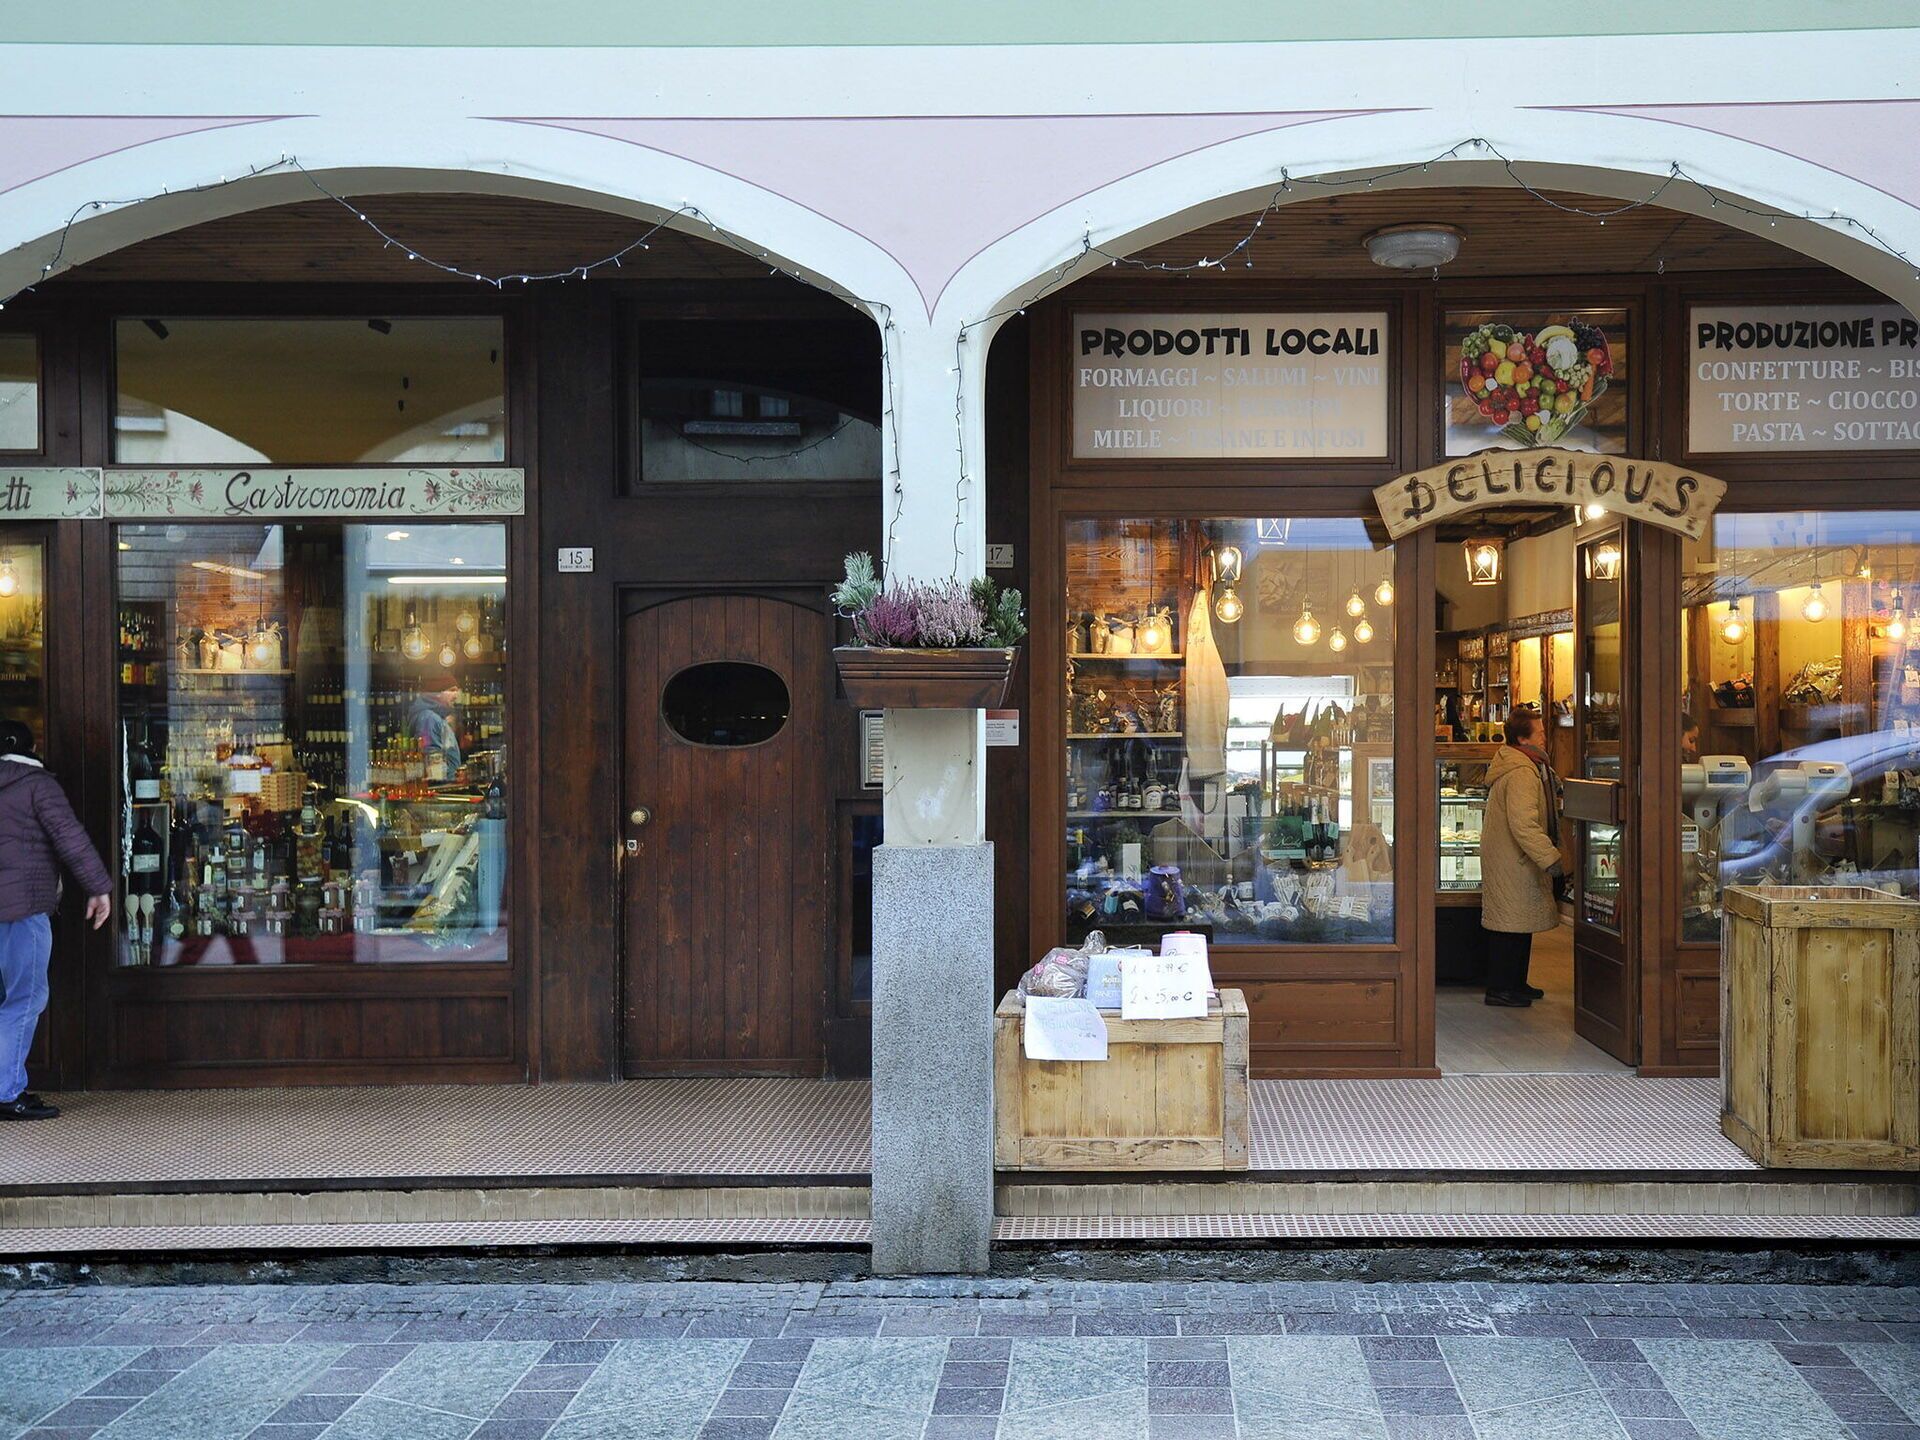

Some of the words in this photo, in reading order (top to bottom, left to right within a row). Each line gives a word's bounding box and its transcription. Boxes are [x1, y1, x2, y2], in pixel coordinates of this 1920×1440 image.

[1081, 327, 1250, 359] PRODOTTI
[1266, 327, 1379, 356] LOCALI
[1697, 317, 1875, 351] PRODUZIONE
[1882, 317, 1920, 349] PR
[1079, 367, 1199, 388] FORMAGGI
[1222, 367, 1308, 386] SALUMI
[1333, 367, 1380, 385] VINI
[1697, 359, 1862, 381] CONFETTURE
[1119, 398, 1213, 422] LIQUORI
[1718, 391, 1801, 411] TORTE
[1827, 390, 1920, 410] CIOCCO
[1093, 430, 1162, 449] MIELE
[1273, 430, 1286, 448] E
[1292, 429, 1365, 448] INFUSI
[1731, 423, 1806, 443] PASTA
[224, 471, 406, 516] Gastronomia
[1402, 455, 1699, 522] DELICIOUS
[570, 551, 583, 565] 15
[990, 547, 1003, 561] 17
